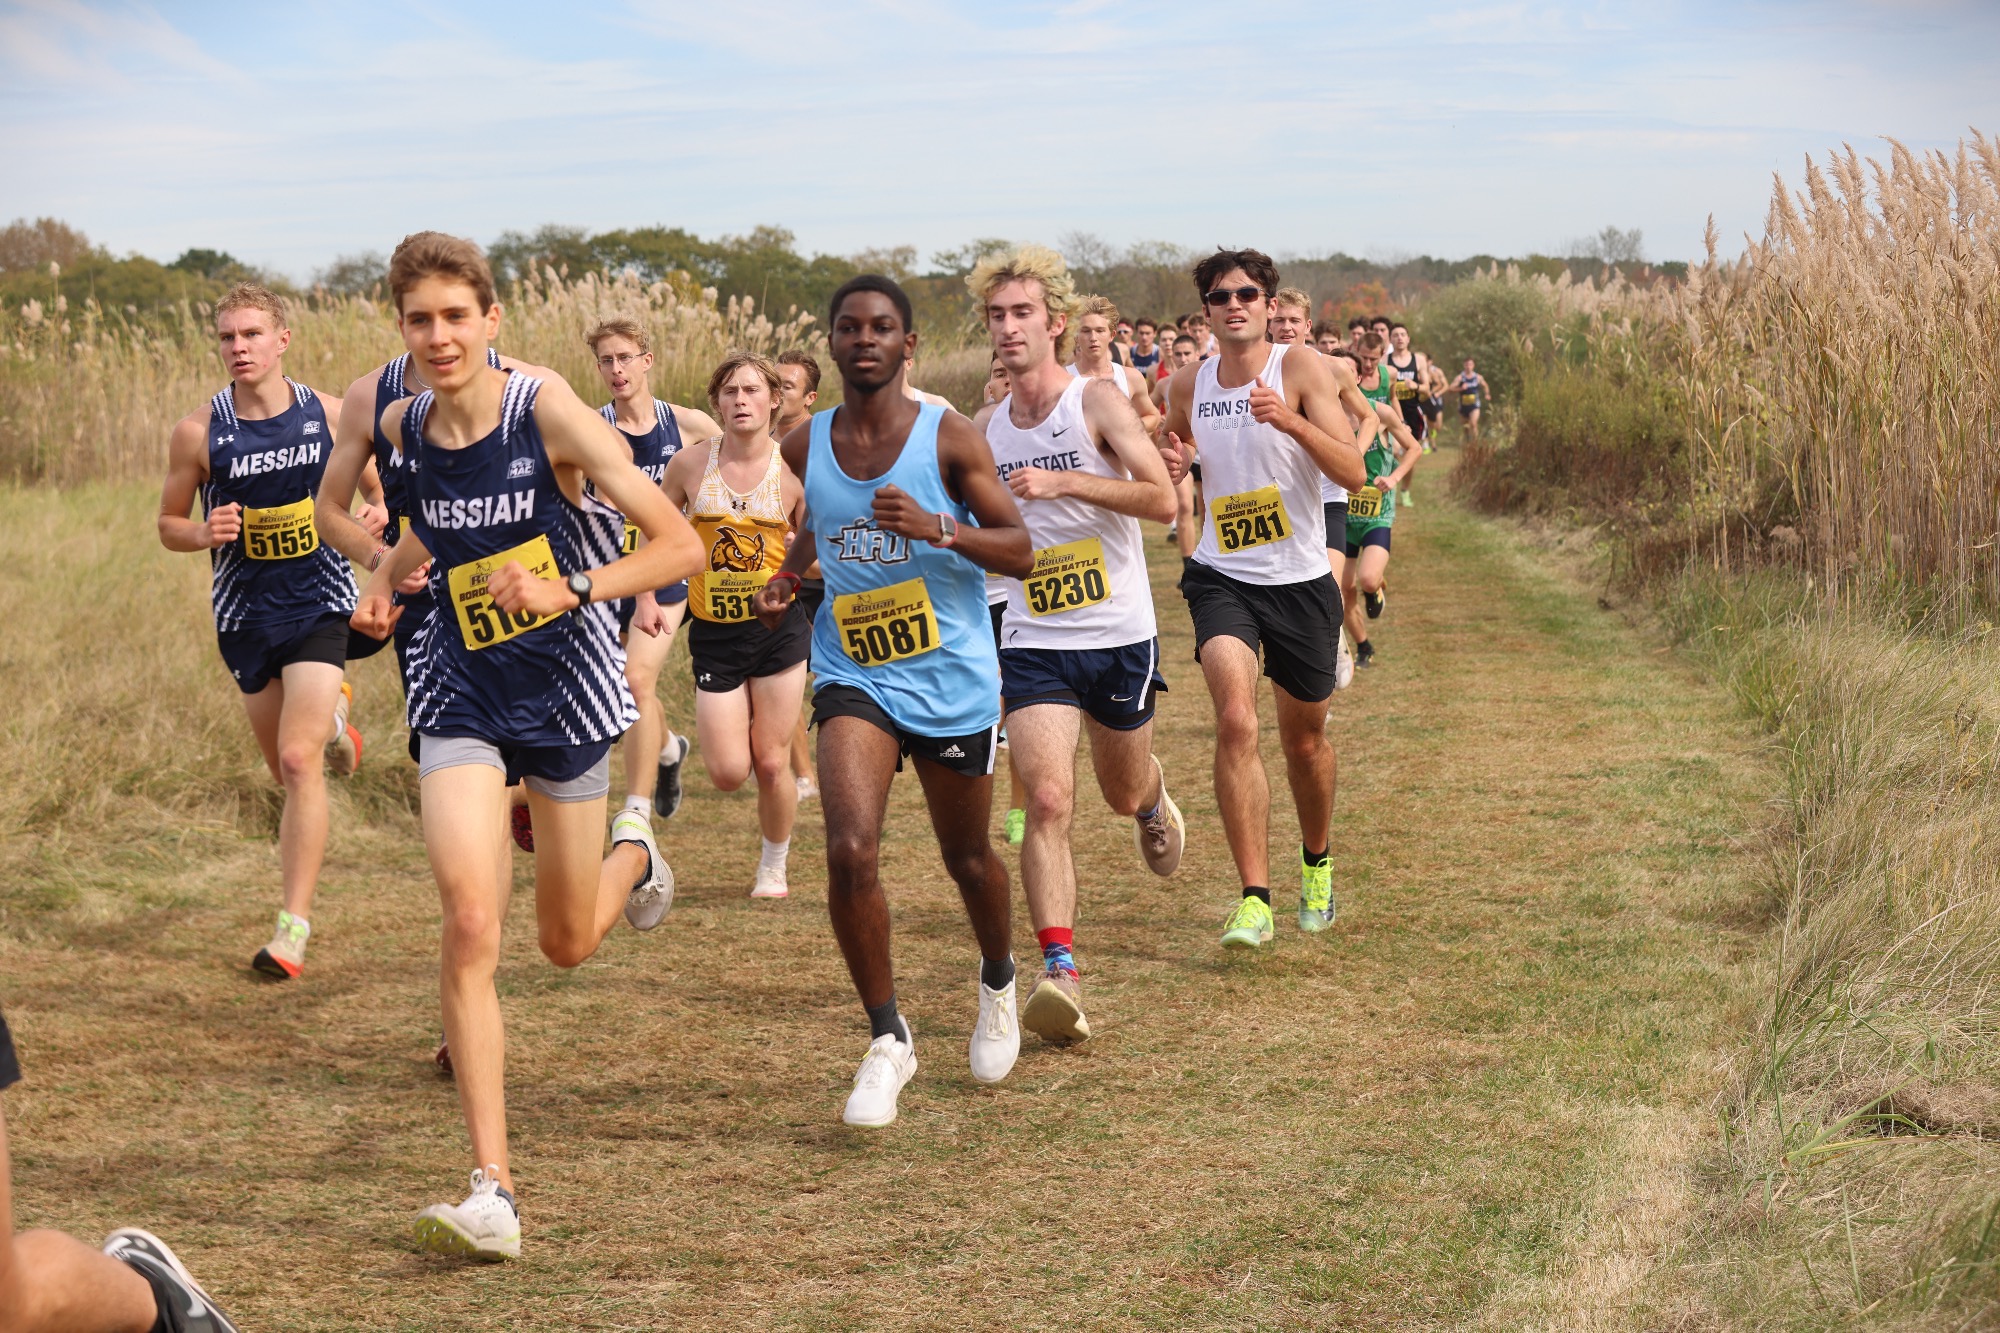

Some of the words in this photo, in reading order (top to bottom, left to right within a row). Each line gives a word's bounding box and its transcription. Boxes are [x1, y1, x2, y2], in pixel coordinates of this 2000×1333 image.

[1198, 401, 1232, 418] PENN
[1212, 418, 1238, 430] CLUB
[229, 442, 321, 478] MESSIAH
[510, 466, 532, 476] MAC
[422, 488, 535, 530] MESSIAH
[1217, 510, 1246, 521] BORDER
[1247, 501, 1278, 515] BATTLE
[1348, 498, 1377, 516] 967
[282, 514, 312, 528] BATTLE
[1220, 511, 1284, 550] 5241
[250, 524, 314, 557] 5155
[838, 526, 910, 564] HFU
[1037, 553, 1075, 568] Rowan
[1061, 558, 1098, 572] BATTLE
[460, 586, 489, 602] BORD
[1028, 568, 1105, 613] 5230
[712, 594, 755, 620] 531
[842, 613, 878, 626] BORDER
[881, 601, 924, 619] BATTLE
[852, 598, 896, 616] Rowan
[846, 612, 930, 664] 5087
